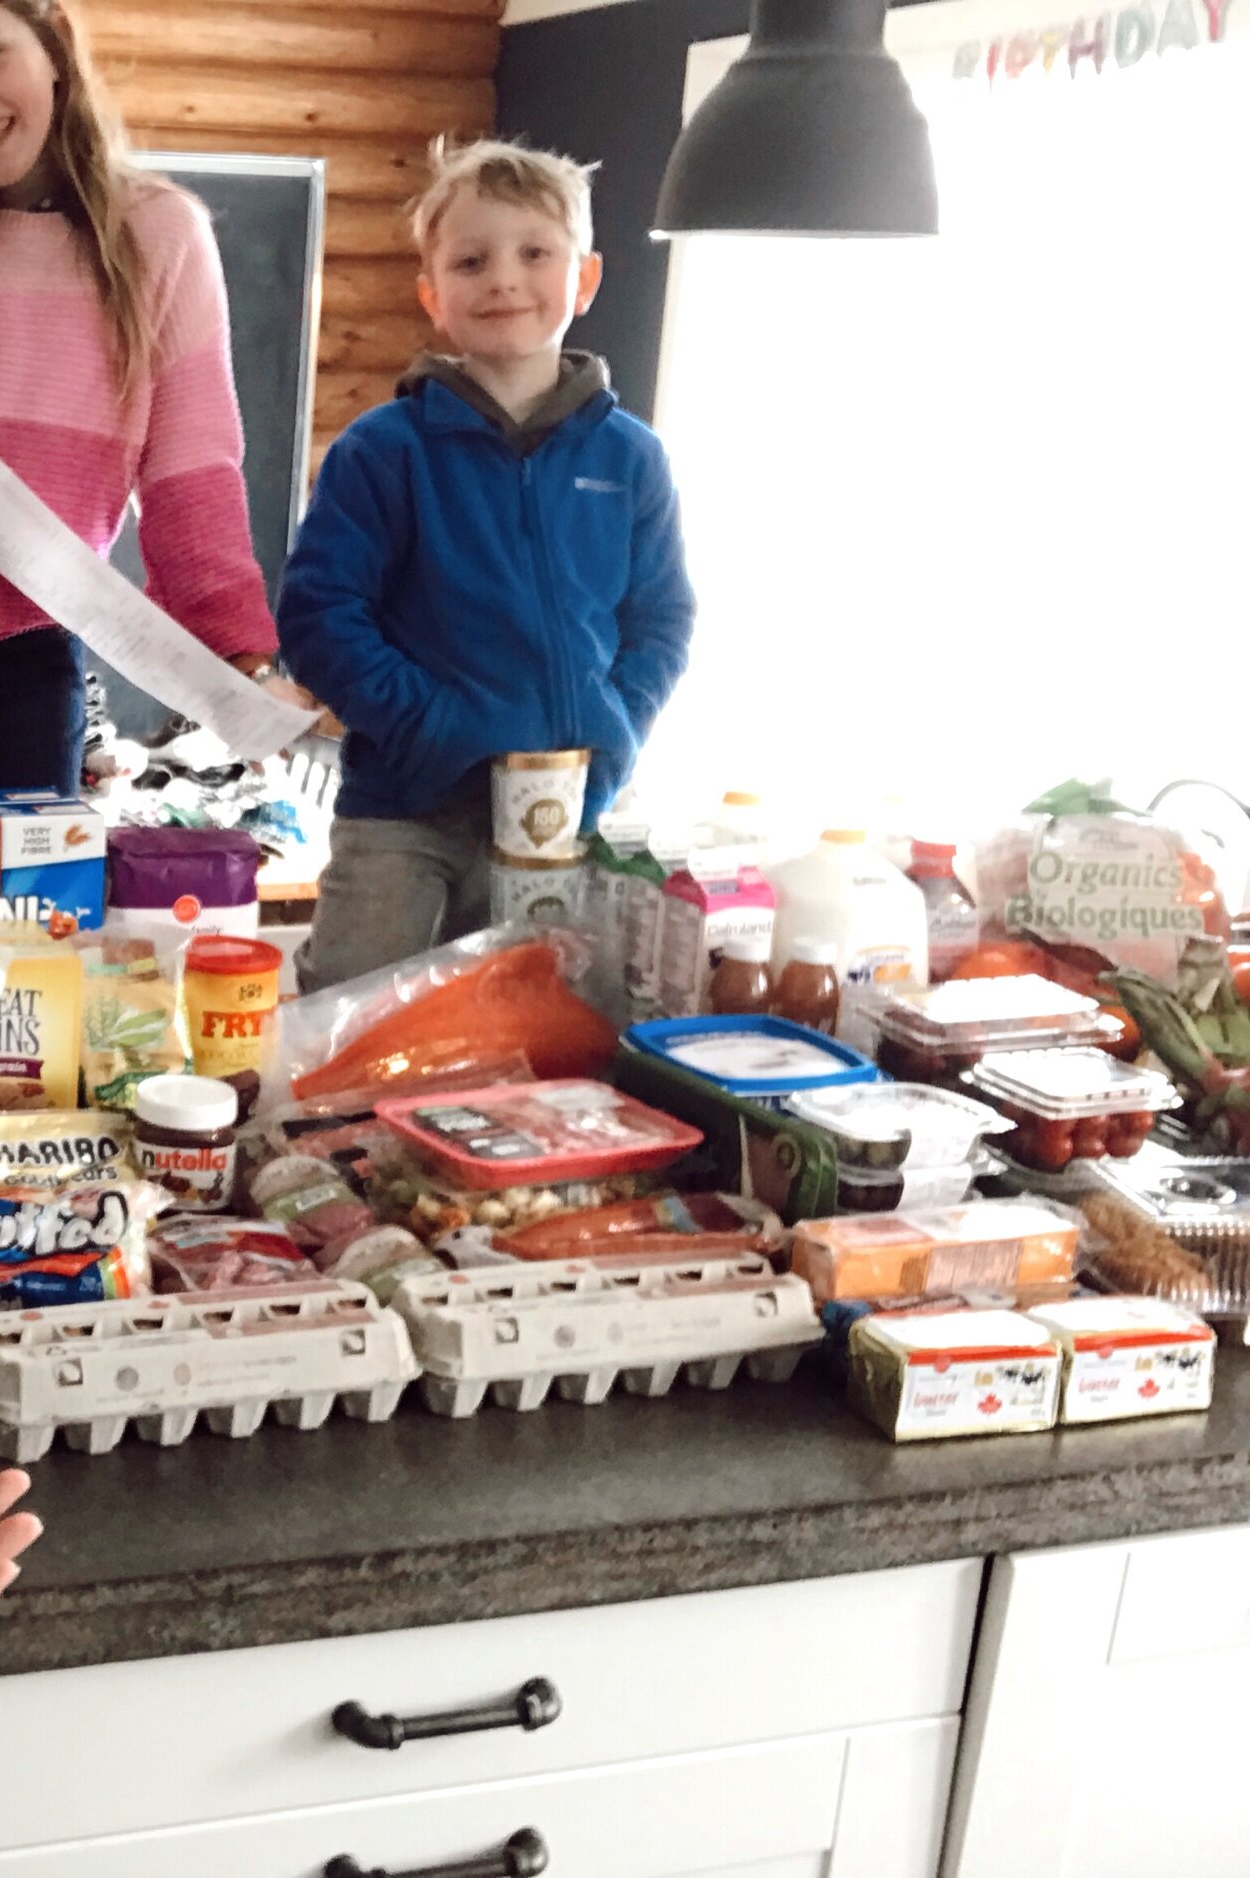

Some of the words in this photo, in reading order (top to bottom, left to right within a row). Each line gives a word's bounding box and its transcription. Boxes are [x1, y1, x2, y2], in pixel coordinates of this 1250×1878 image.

[22, 827, 51, 836] VERY
[23, 838, 50, 846] HIGH
[1029, 851, 1184, 894] Organics
[1007, 893, 1205, 940] Biologiques
[141, 1147, 228, 1172] nutella
